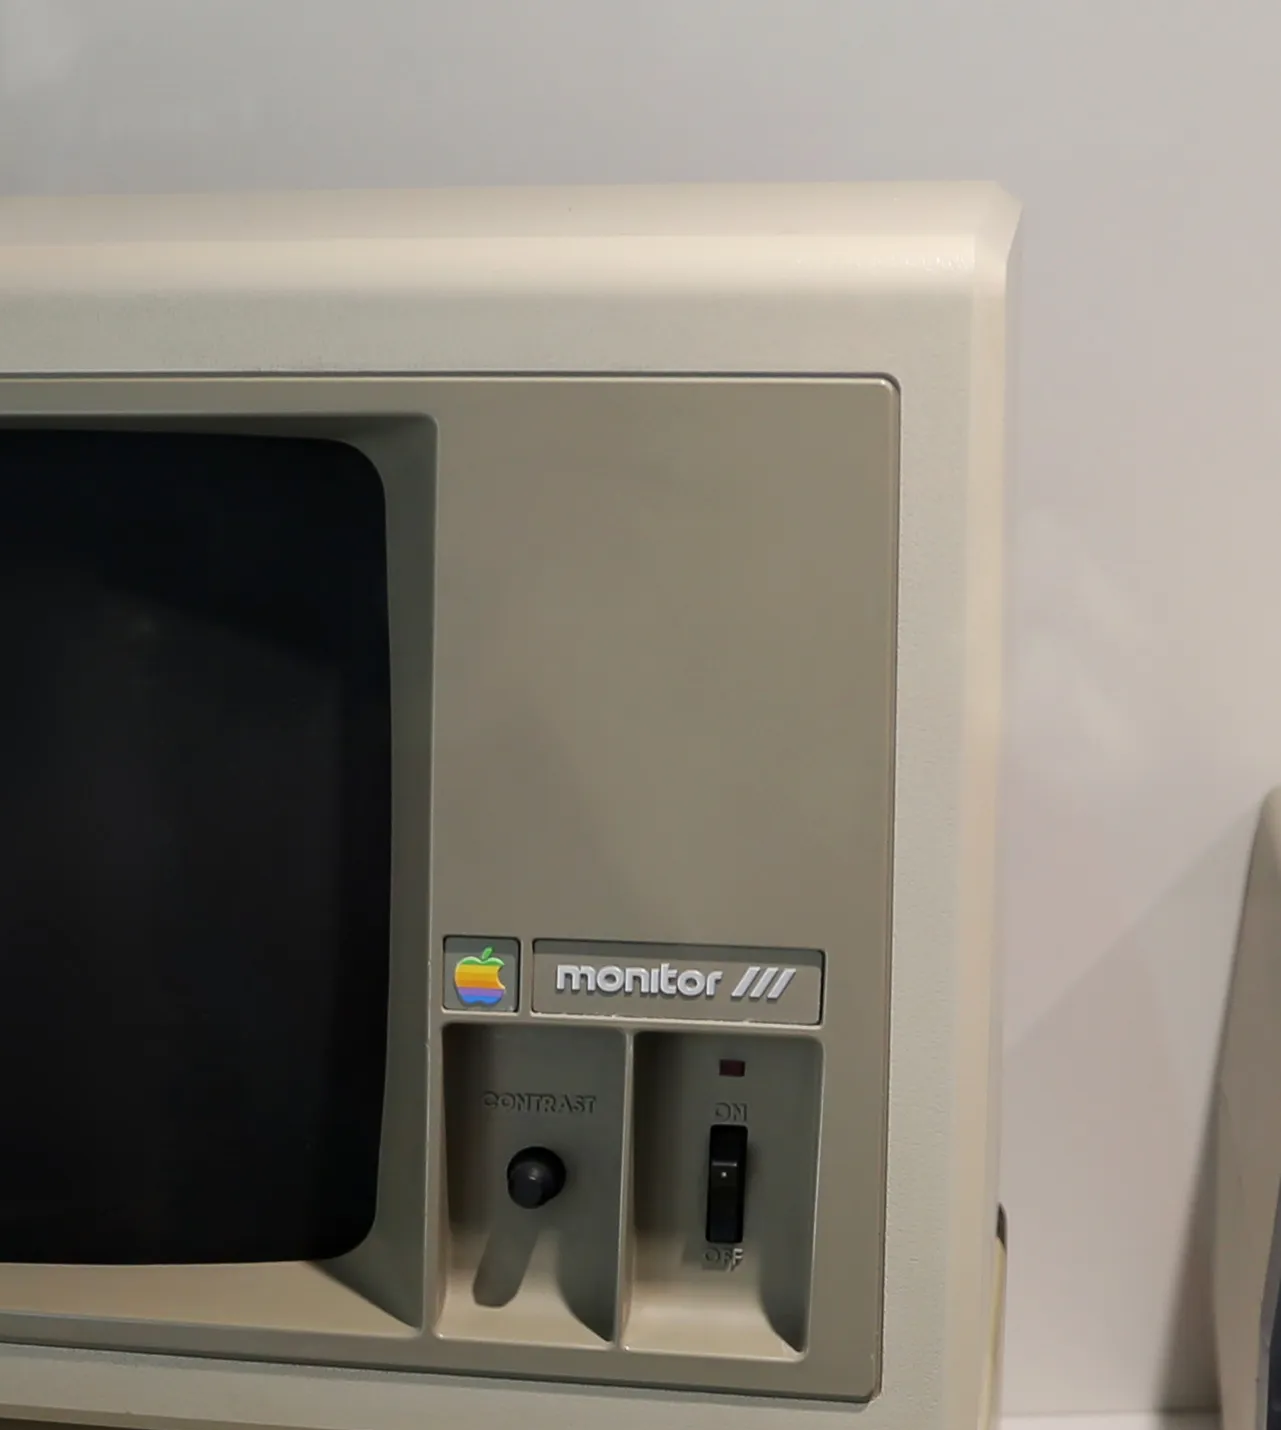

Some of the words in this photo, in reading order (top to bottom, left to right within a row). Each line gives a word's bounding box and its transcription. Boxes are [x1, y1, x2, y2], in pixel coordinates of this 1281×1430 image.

[556, 963, 724, 997] monitor
[483, 1090, 597, 1115] CONTRAST
[715, 1102, 748, 1123] ON
[704, 1247, 744, 1272] OFF
